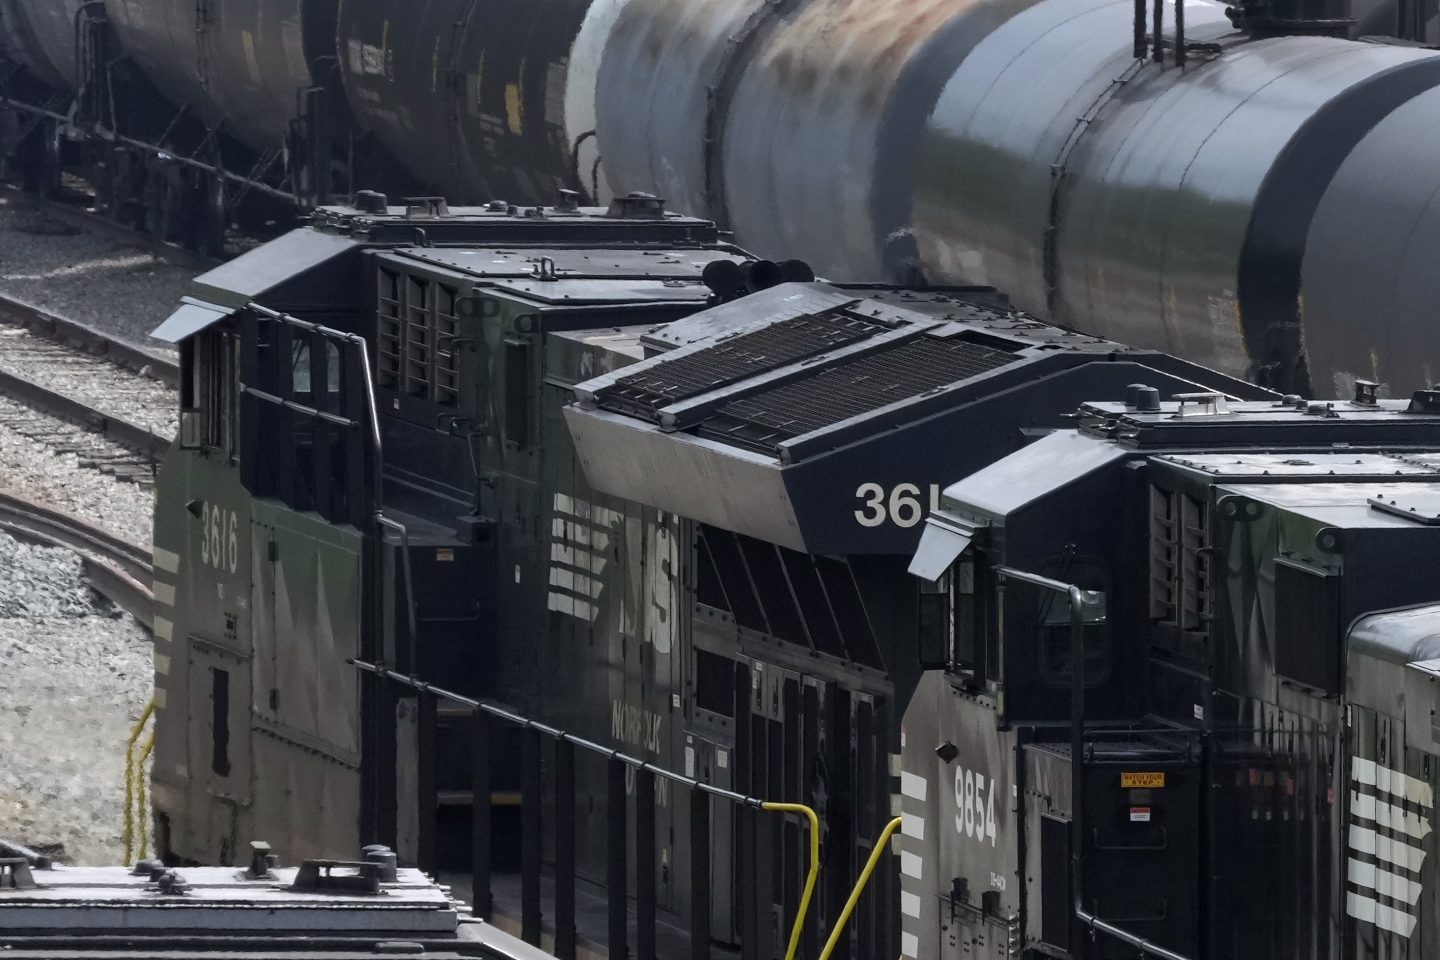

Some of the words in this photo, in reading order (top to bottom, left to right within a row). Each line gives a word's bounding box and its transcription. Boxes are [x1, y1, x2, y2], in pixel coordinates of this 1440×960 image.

[201, 500, 238, 574] 3616
[854, 482, 940, 527] 361
[954, 765, 997, 848] 9854
